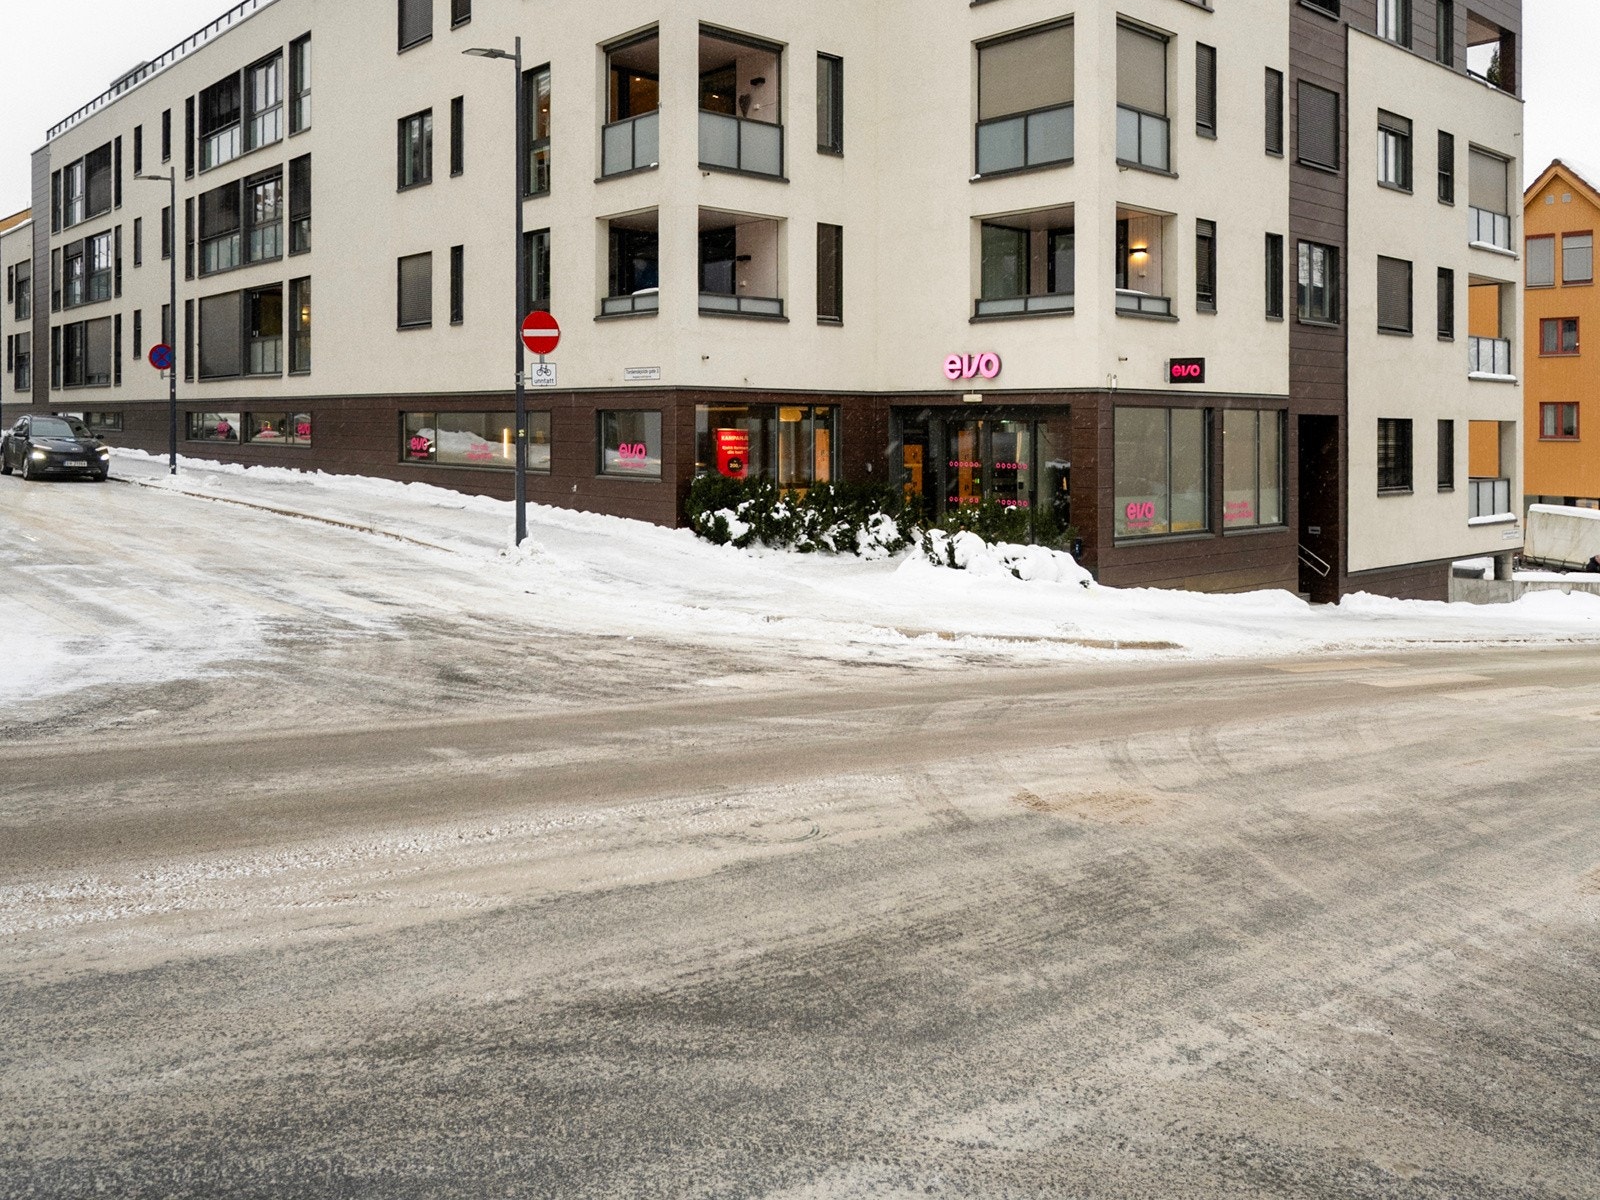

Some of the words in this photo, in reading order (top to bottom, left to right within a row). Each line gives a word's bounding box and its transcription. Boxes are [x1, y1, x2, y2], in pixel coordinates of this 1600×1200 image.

[944, 352, 1001, 380] evo
[1171, 364, 1200, 377] evo
[618, 443, 647, 460] evo
[1126, 501, 1155, 520] evo
